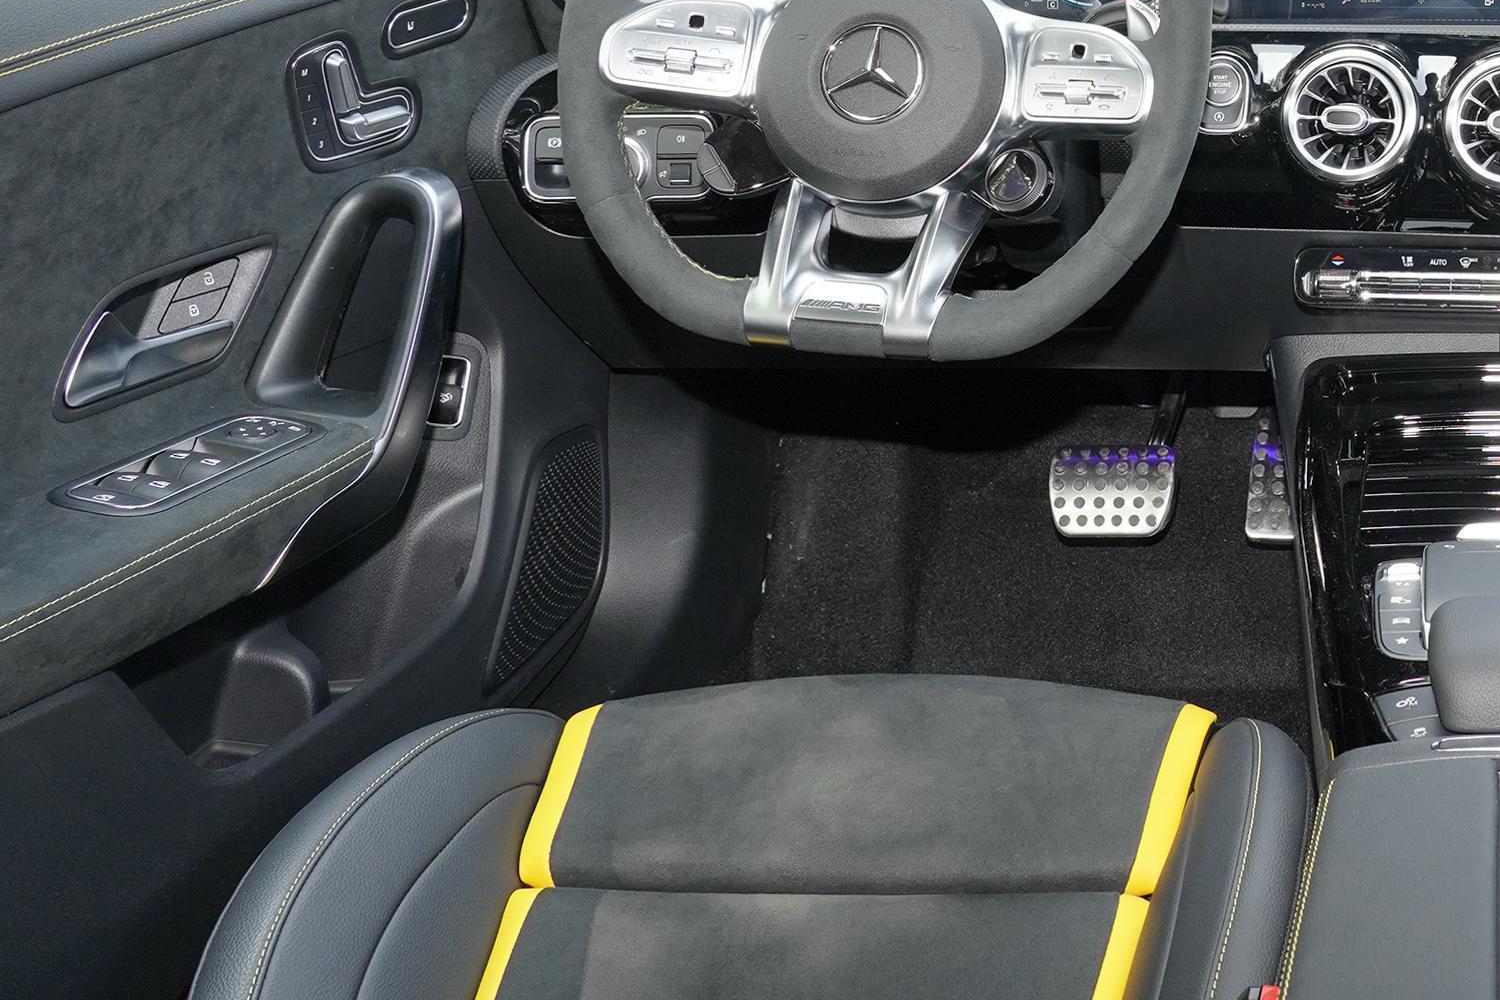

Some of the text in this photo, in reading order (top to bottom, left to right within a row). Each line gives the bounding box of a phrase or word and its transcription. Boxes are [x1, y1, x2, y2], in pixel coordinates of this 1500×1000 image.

[307, 94, 312, 102] 1
[312, 117, 318, 126] 2
[318, 140, 324, 149] 3
[1429, 258, 1448, 266] AUTO
